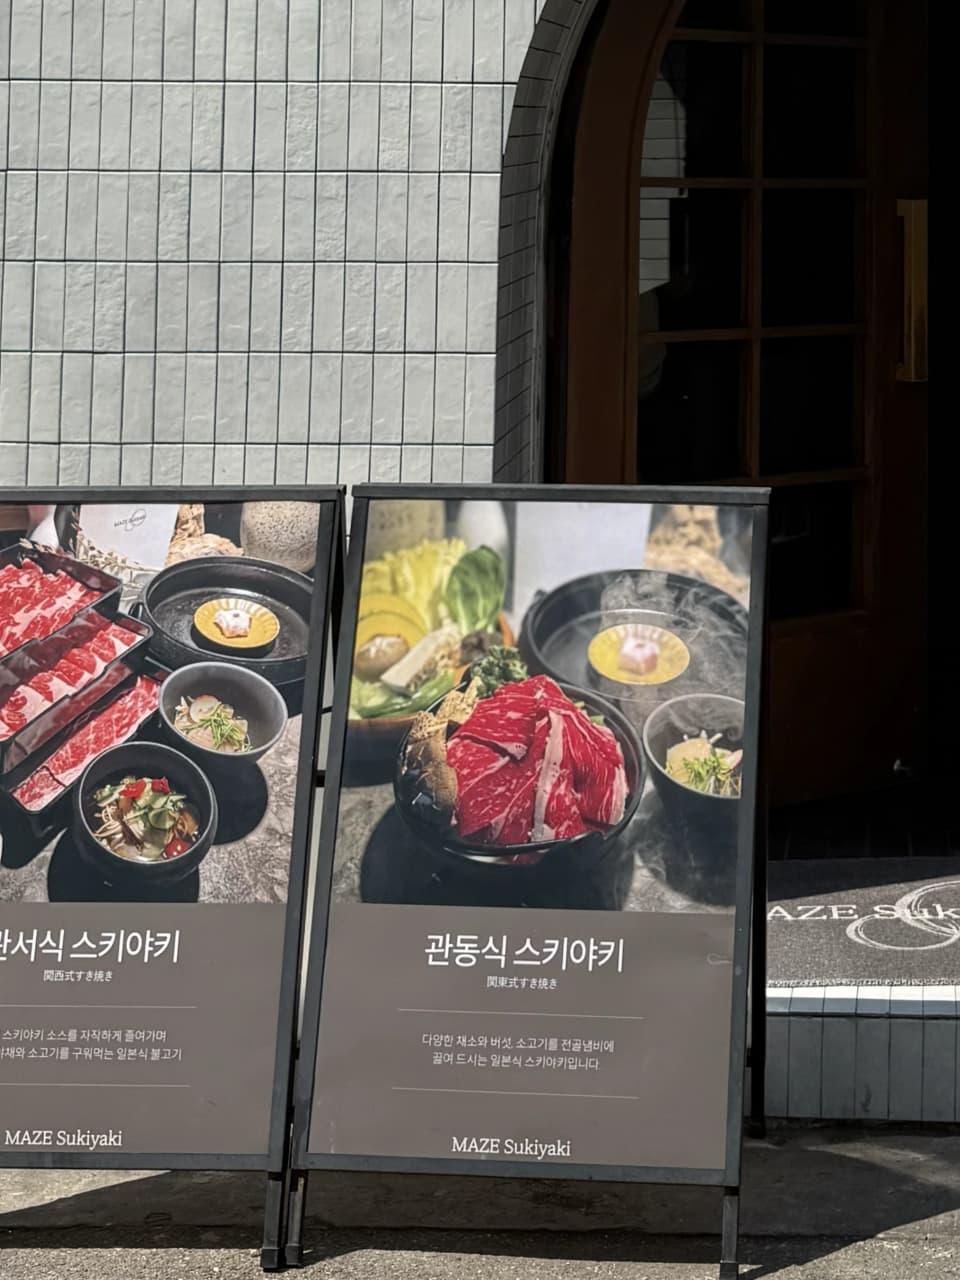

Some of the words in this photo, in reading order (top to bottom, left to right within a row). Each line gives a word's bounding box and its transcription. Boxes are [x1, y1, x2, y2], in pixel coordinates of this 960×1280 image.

[767, 905, 858, 920] AZE
[69, 929, 180, 963] 스키야키
[425, 933, 508, 968] 관동식
[513, 937, 624, 973] 스키야키
[2, 1028, 44, 1041] 스키야키
[46, 1029, 77, 1042] 소스를
[422, 1033, 454, 1047] 다양한
[456, 1035, 488, 1049] 채소와
[516, 1038, 558, 1051] 소고기를
[27, 1047, 70, 1061] 소고기를
[116, 1048, 148, 1061] 일본식
[456, 1053, 489, 1067] 드시는
[490, 1054, 523, 1069] 일본식
[4, 1129, 53, 1145] MAZE
[56, 1129, 123, 1151] Sukiyaki
[451, 1136, 501, 1154] MAZE
[504, 1137, 571, 1160] Sukiyaki
